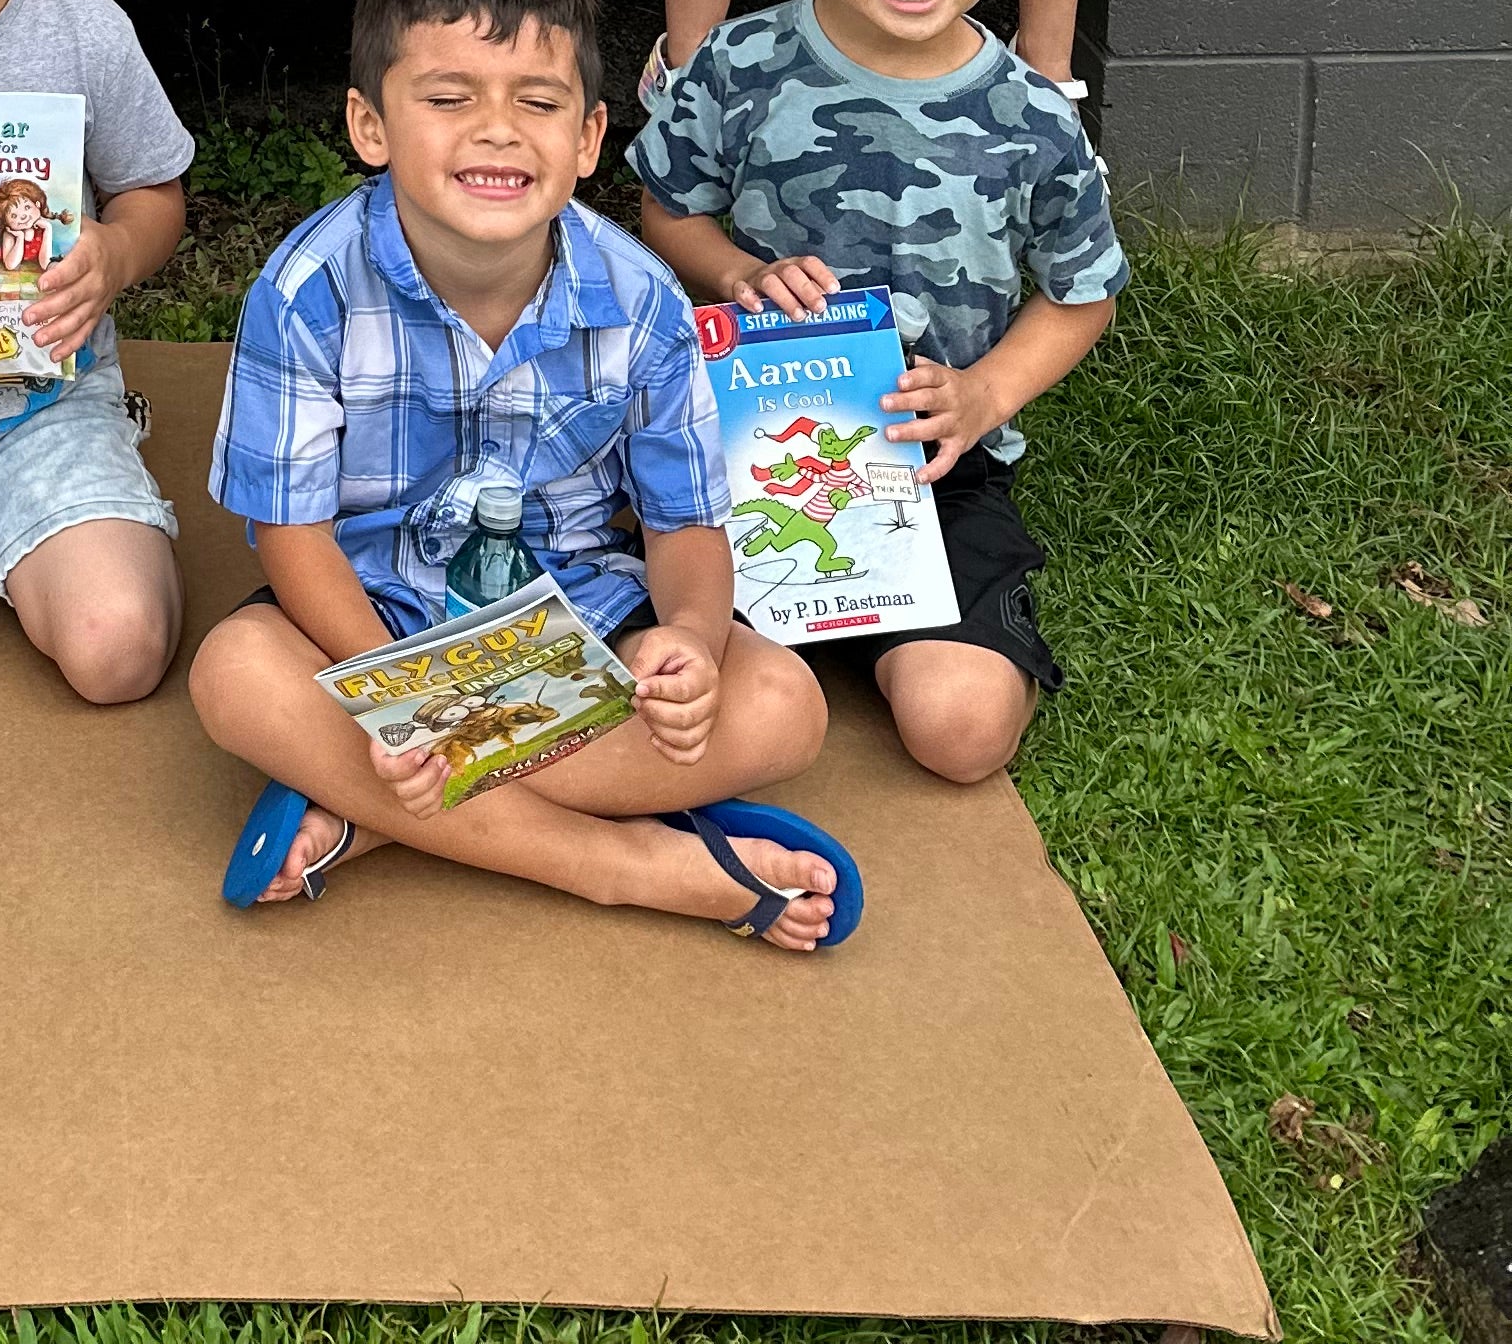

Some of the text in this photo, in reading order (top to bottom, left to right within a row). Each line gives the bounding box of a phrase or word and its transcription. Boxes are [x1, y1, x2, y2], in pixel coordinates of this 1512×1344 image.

[705, 317, 719, 344] 1
[745, 313, 779, 330] STEP
[805, 304, 868, 324] READING
[728, 355, 855, 392] Aaron
[757, 388, 834, 413] Is Cool
[869, 469, 910, 482] DANGER
[875, 485, 912, 495] THIN ICE
[769, 593, 915, 625] by P. D. Eastman
[816, 615, 879, 630] SCHOLASTIC
[334, 607, 549, 699] FLY GUY
[462, 637, 576, 695] INSECTS
[540, 727, 595, 761] Arnold
